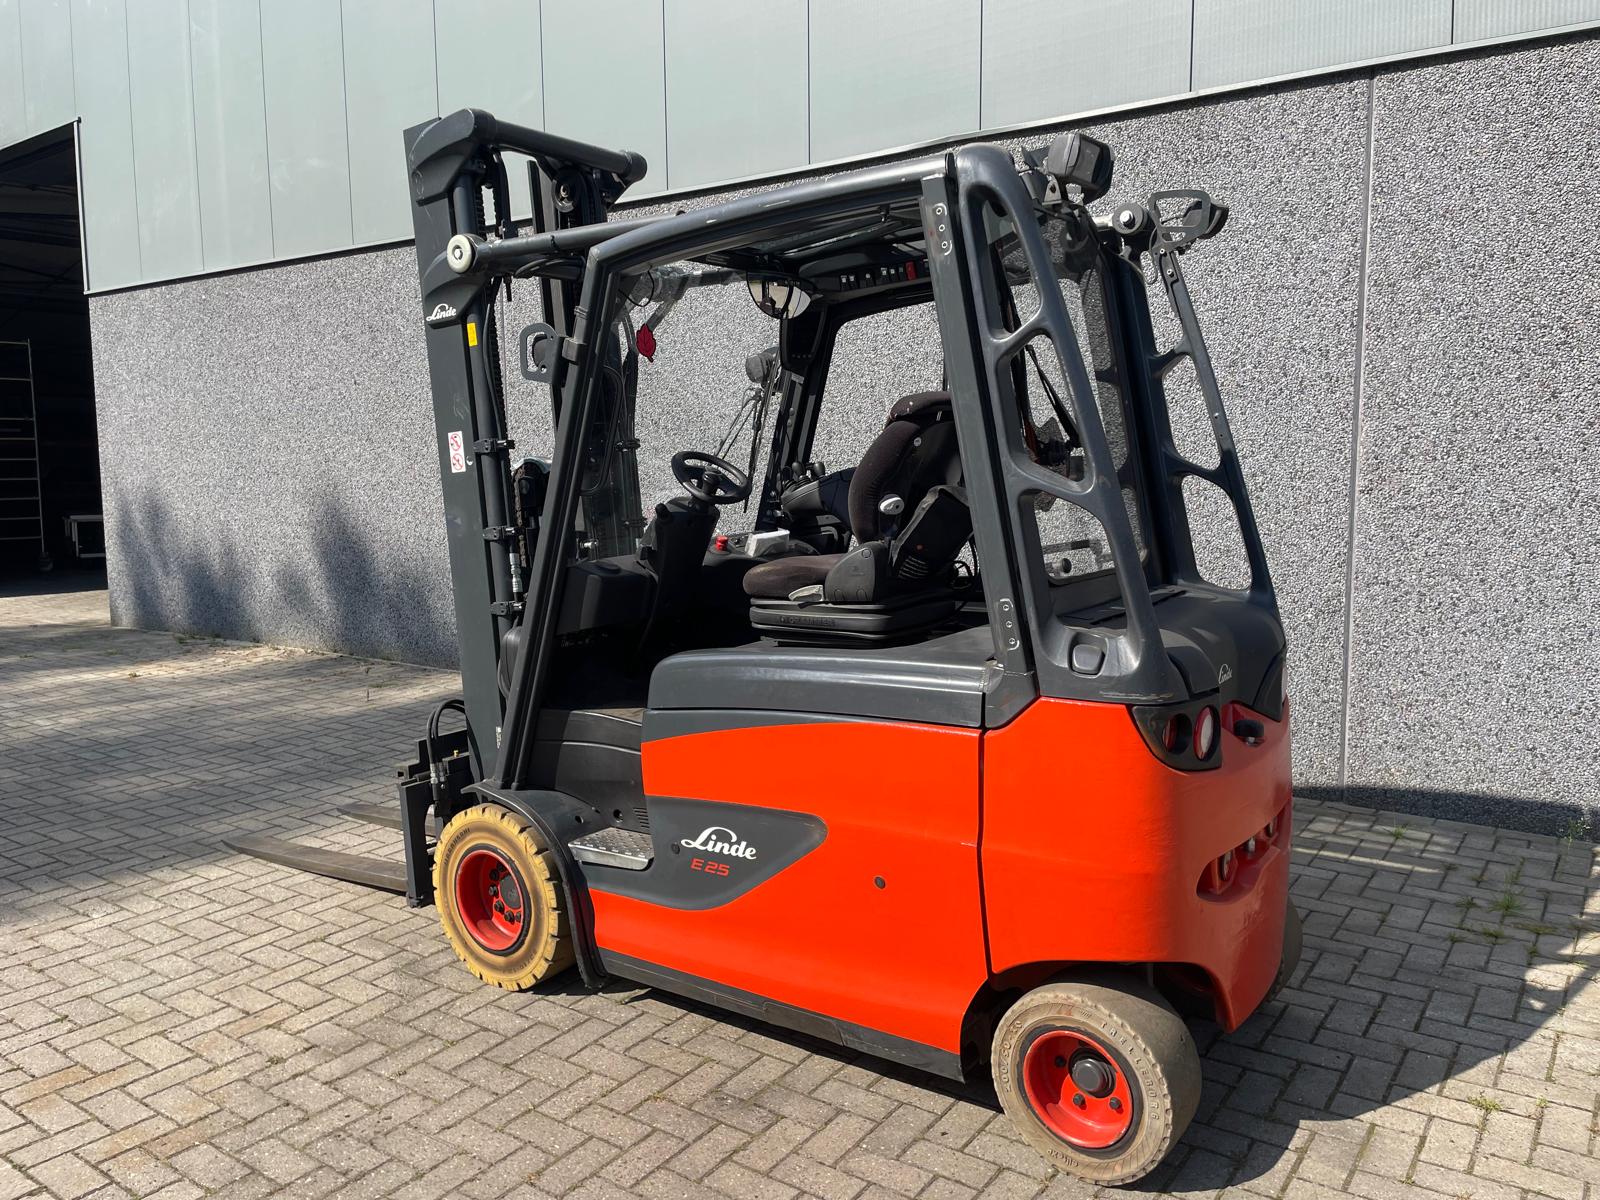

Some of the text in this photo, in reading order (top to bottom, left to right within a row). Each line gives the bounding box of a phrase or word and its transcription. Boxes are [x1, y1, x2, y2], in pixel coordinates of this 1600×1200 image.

[426, 303, 457, 321] Linde
[680, 826, 757, 860] Linde
[690, 857, 730, 877] E 25
[1101, 1021, 1160, 1121] TRELLEBORG
